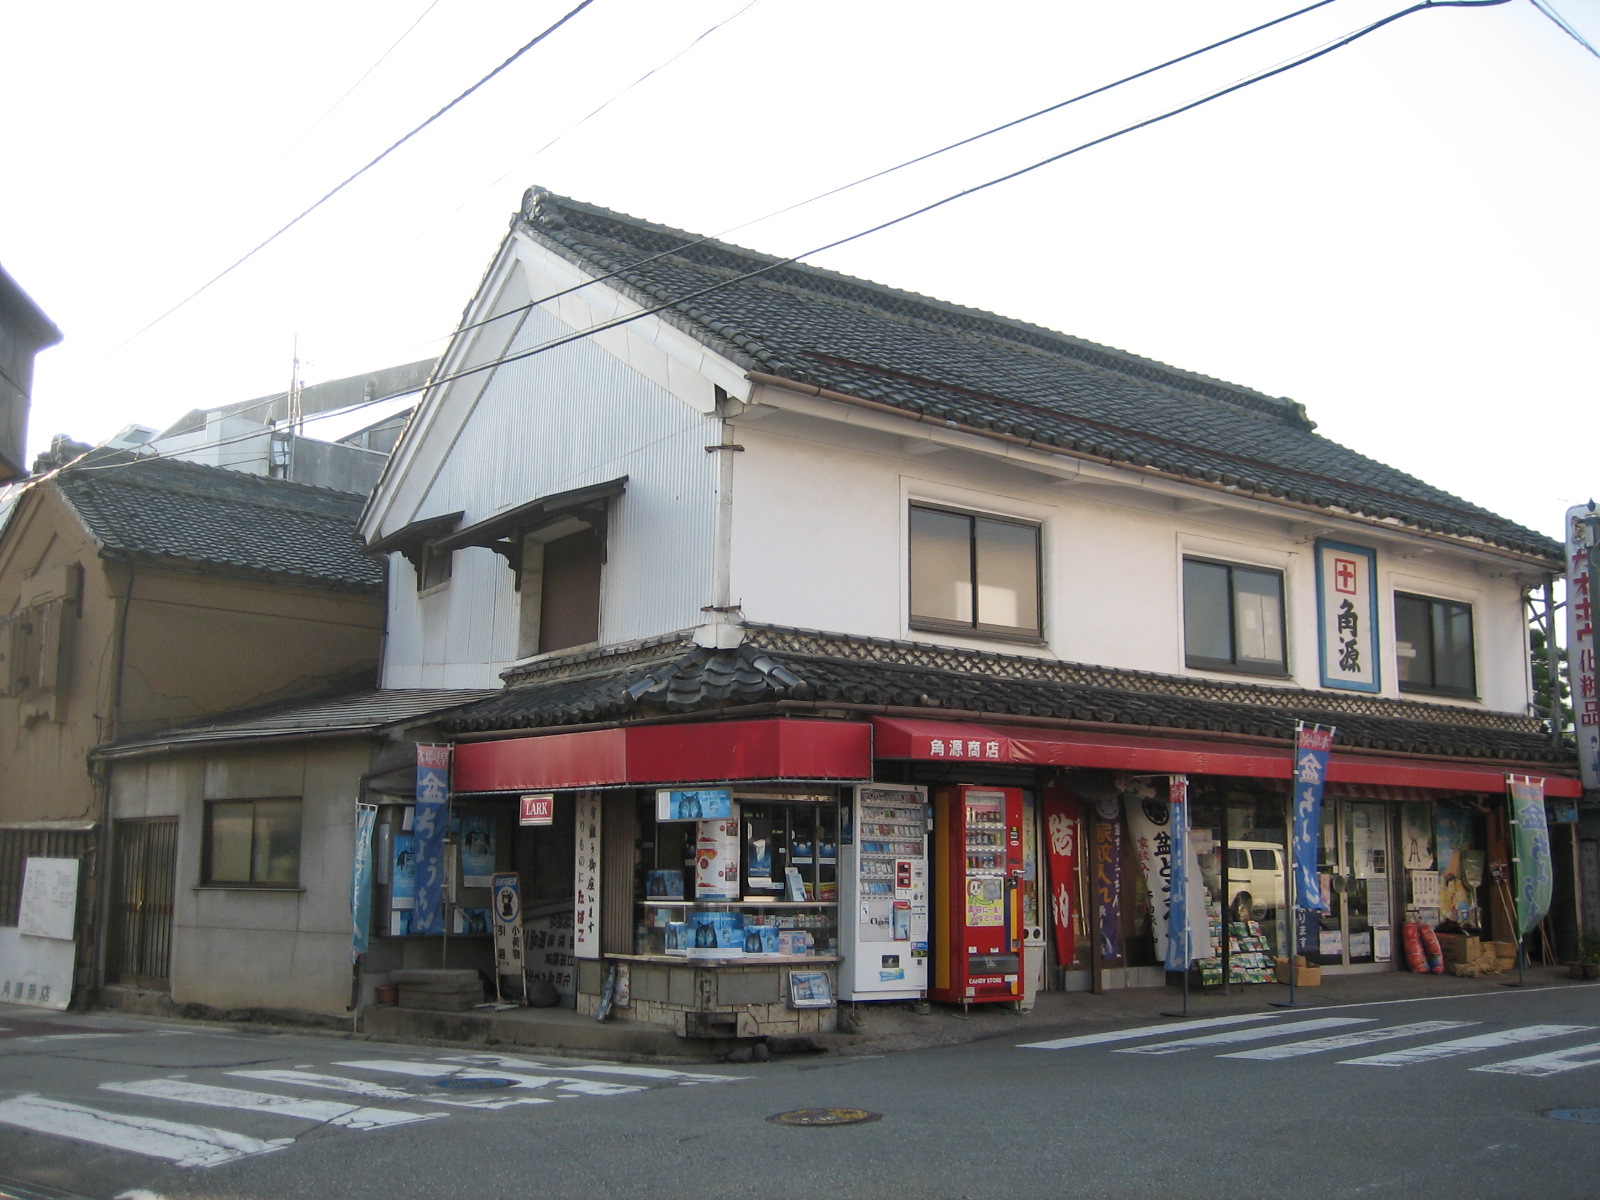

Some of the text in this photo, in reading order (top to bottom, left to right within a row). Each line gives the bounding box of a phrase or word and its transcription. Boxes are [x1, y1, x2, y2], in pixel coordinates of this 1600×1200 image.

[1337, 598, 1361, 673] 角源
[930, 739, 1000, 758] 角源商店
[526, 801, 548, 816] LARK
[416, 772, 447, 931] 盆ちょうちん
